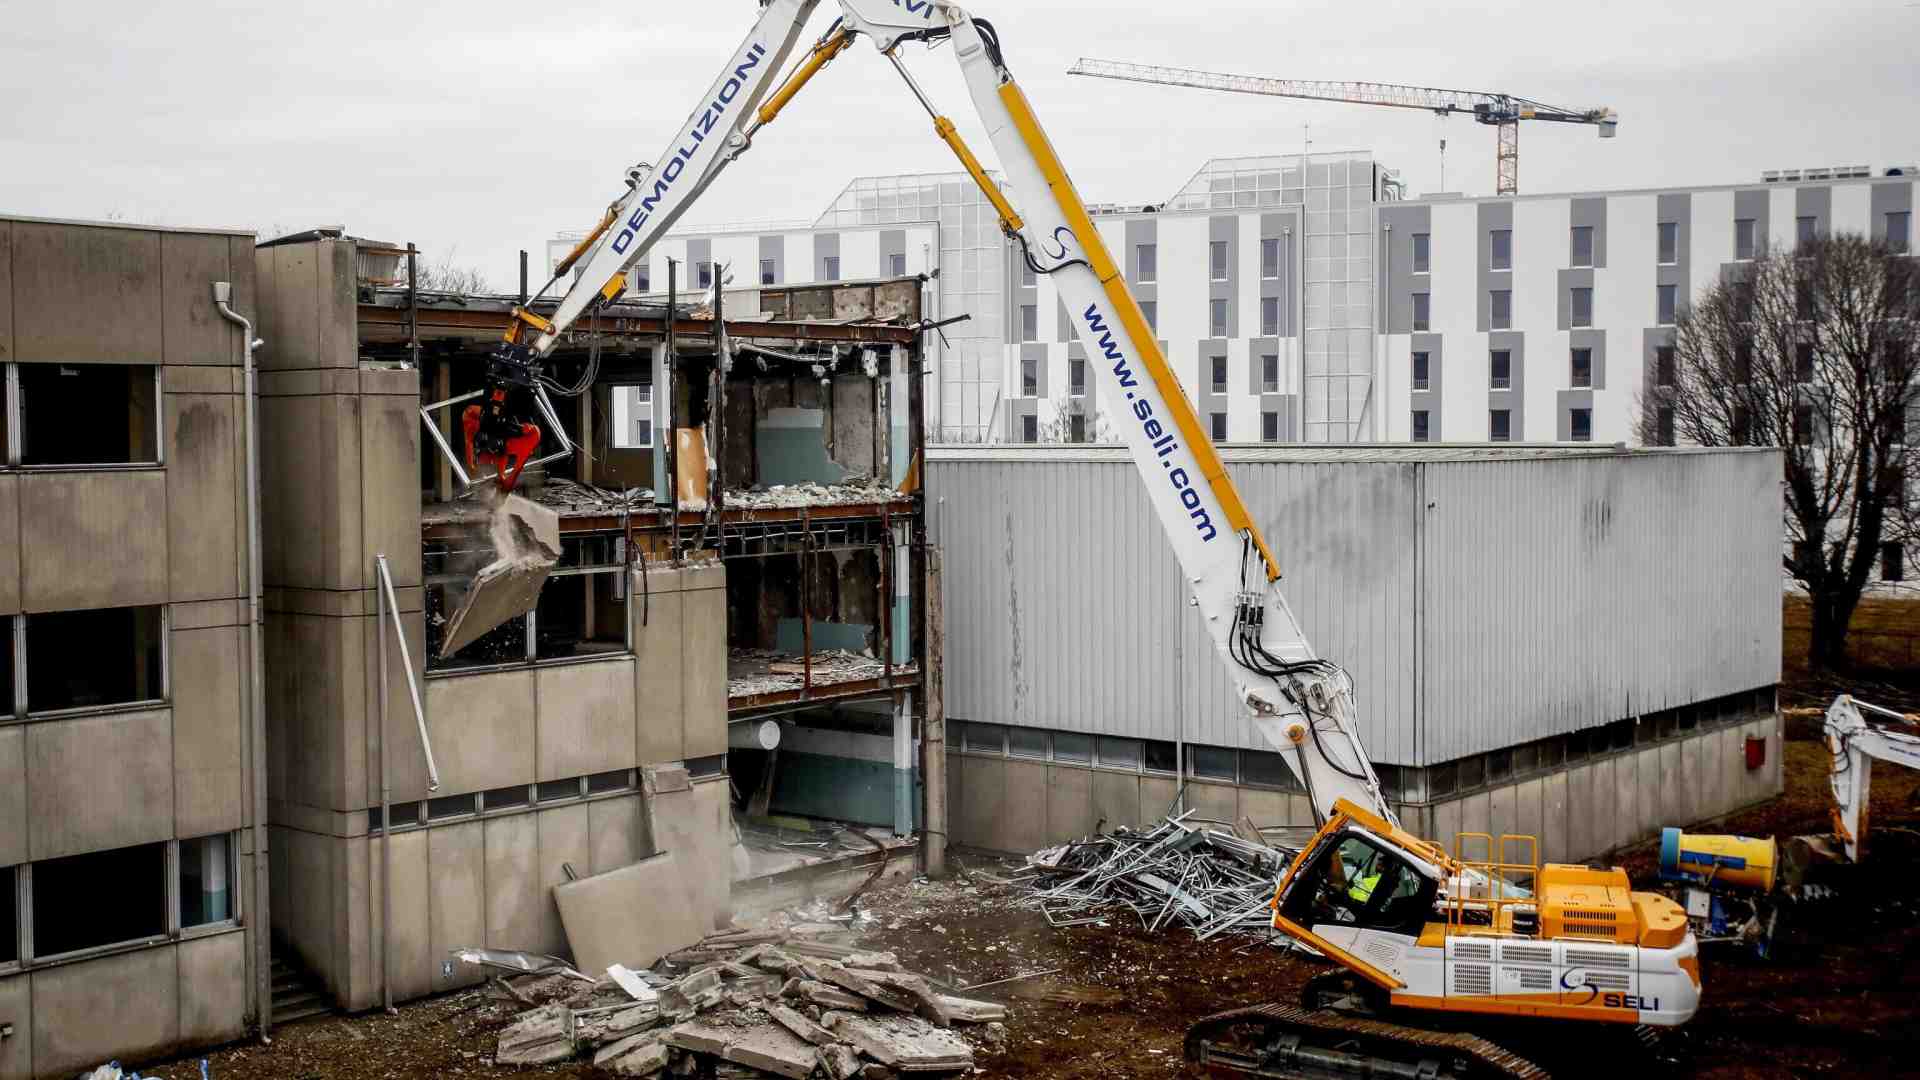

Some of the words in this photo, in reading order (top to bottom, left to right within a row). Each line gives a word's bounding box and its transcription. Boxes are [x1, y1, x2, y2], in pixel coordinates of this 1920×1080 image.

[611, 42, 767, 256] DEMOLIZIONI
[1083, 303, 1217, 543] www.seli.com
[1603, 993, 1660, 1012] SELI
